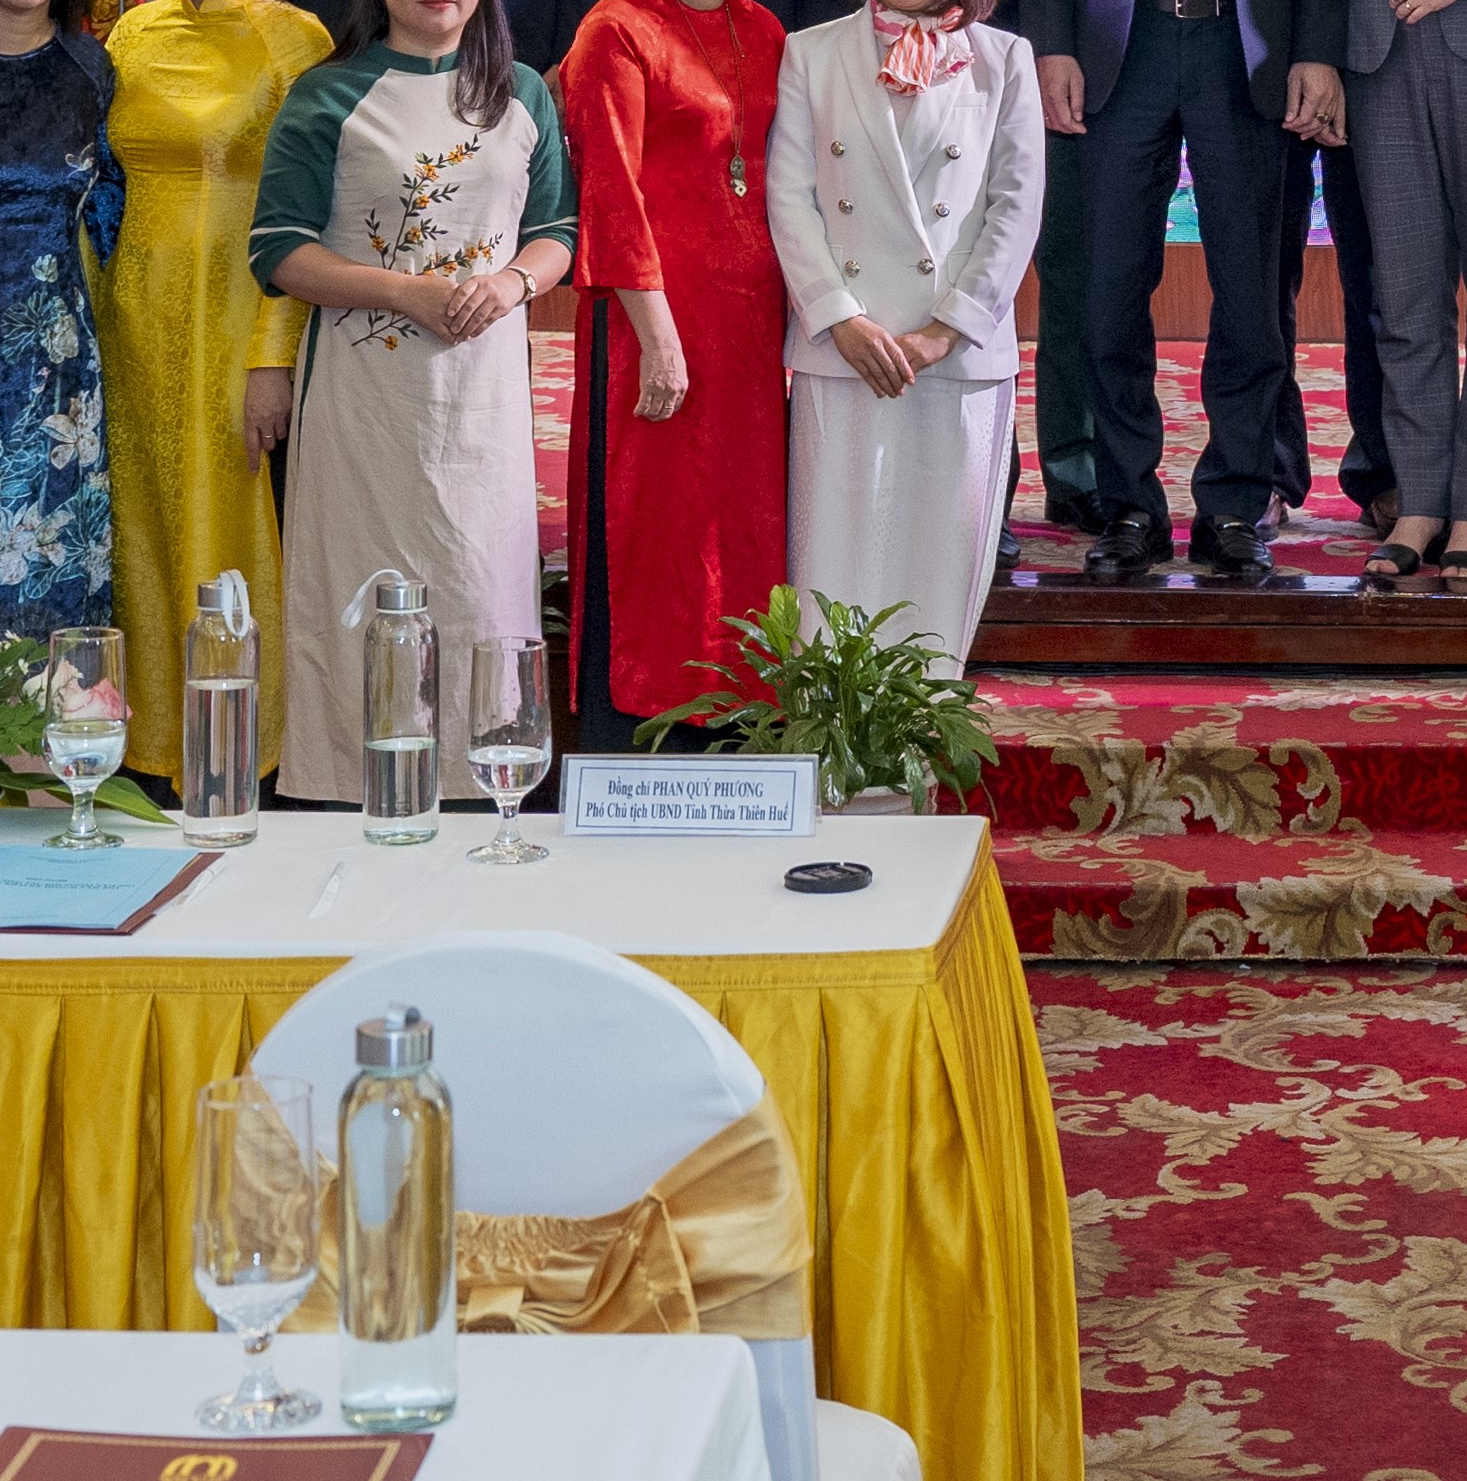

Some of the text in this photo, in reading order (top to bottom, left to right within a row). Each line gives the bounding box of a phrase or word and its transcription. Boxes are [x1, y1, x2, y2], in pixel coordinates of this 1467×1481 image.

[608, 776, 764, 800] Đồng chí PHAN QUÝ PHƯƠNG
[586, 802, 605, 817] Phó
[630, 803, 647, 822] tịch
[651, 804, 682, 819] UBND
[739, 805, 765, 820] Thiên
[769, 801, 789, 820] Huế
